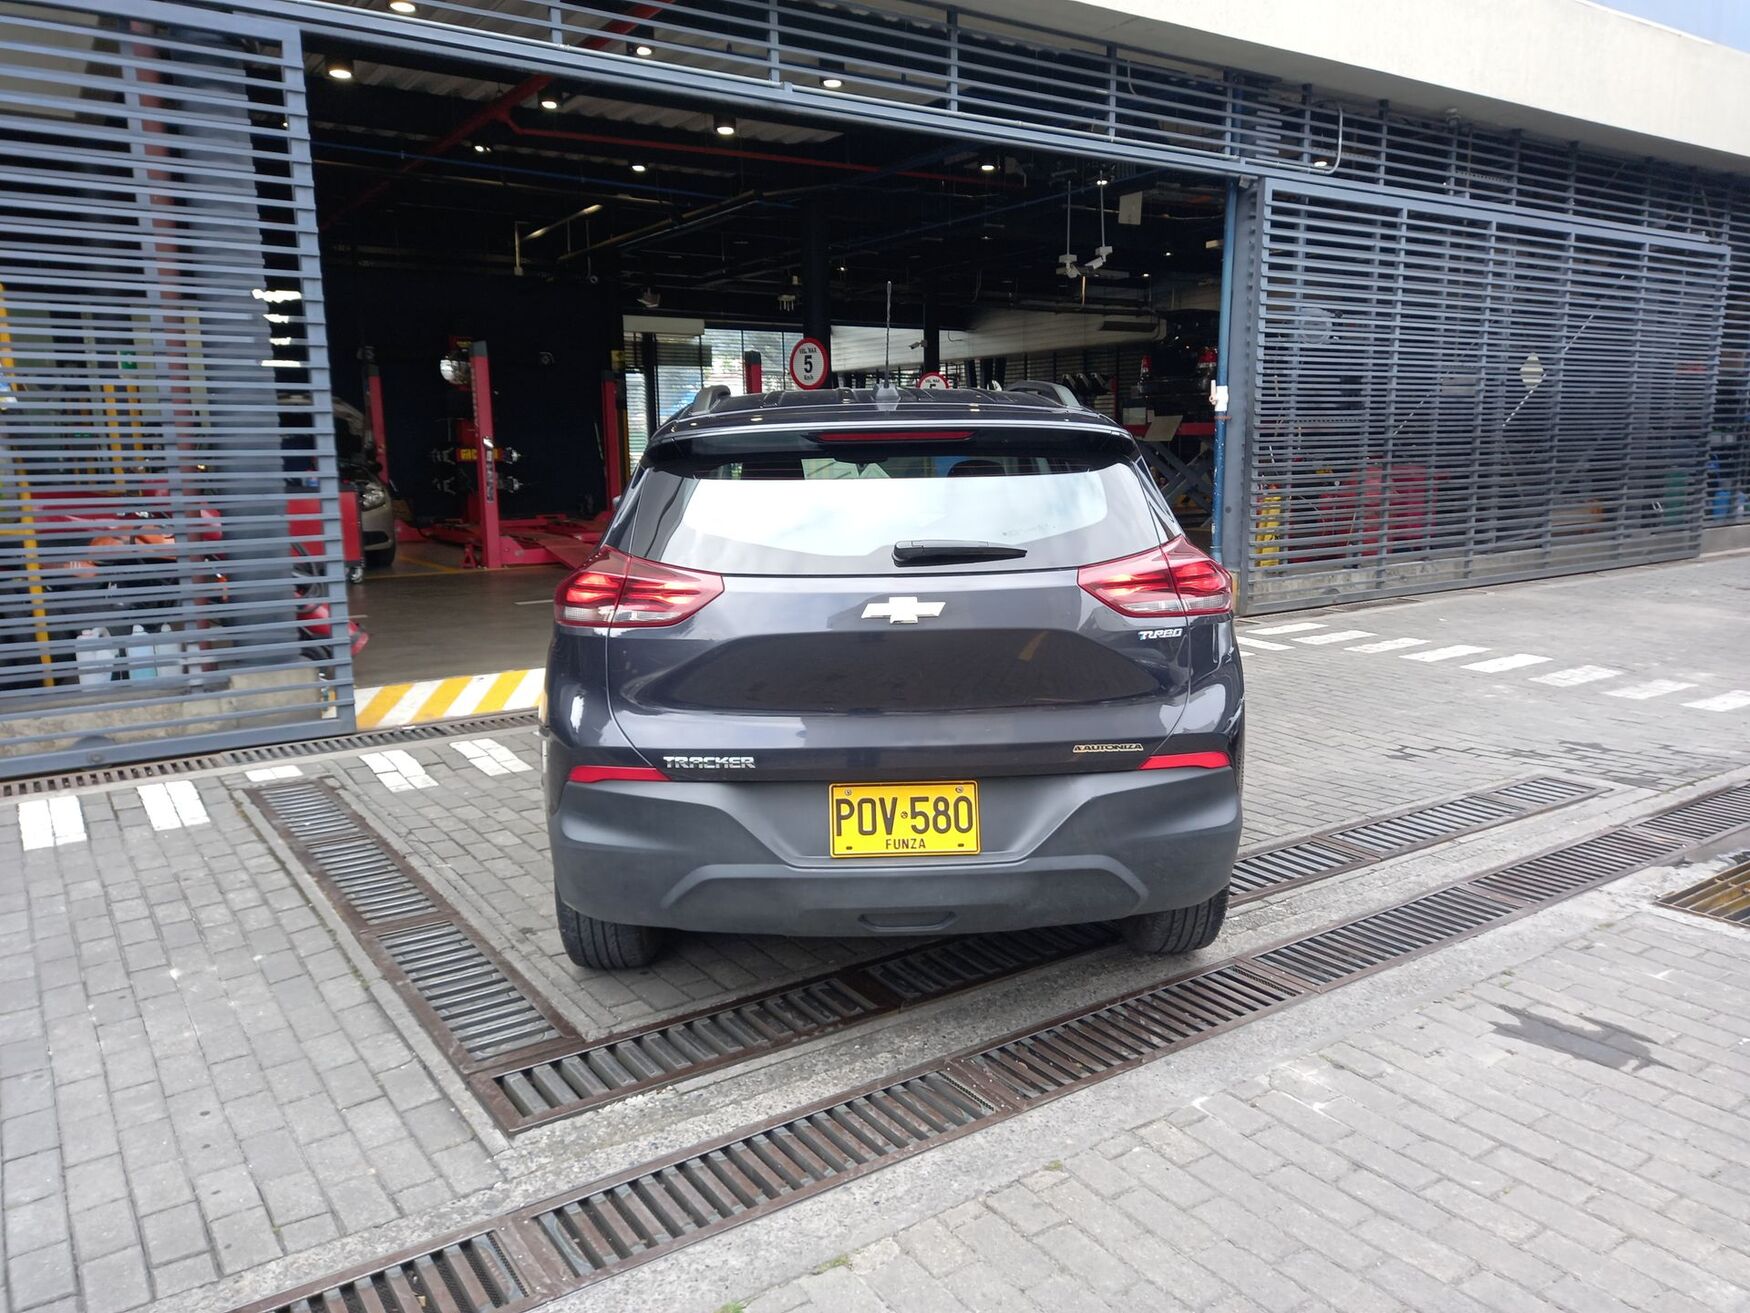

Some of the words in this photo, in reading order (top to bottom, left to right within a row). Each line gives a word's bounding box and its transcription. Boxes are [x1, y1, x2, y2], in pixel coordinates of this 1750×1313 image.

[804, 354, 813, 373] 5
[1138, 628, 1183, 640] TURBO
[1084, 743, 1142, 752] AUTONIZA
[663, 756, 756, 768] TRACKER
[835, 796, 898, 837] POV
[910, 795, 973, 835] 580
[885, 838, 926, 849] FUNZA
